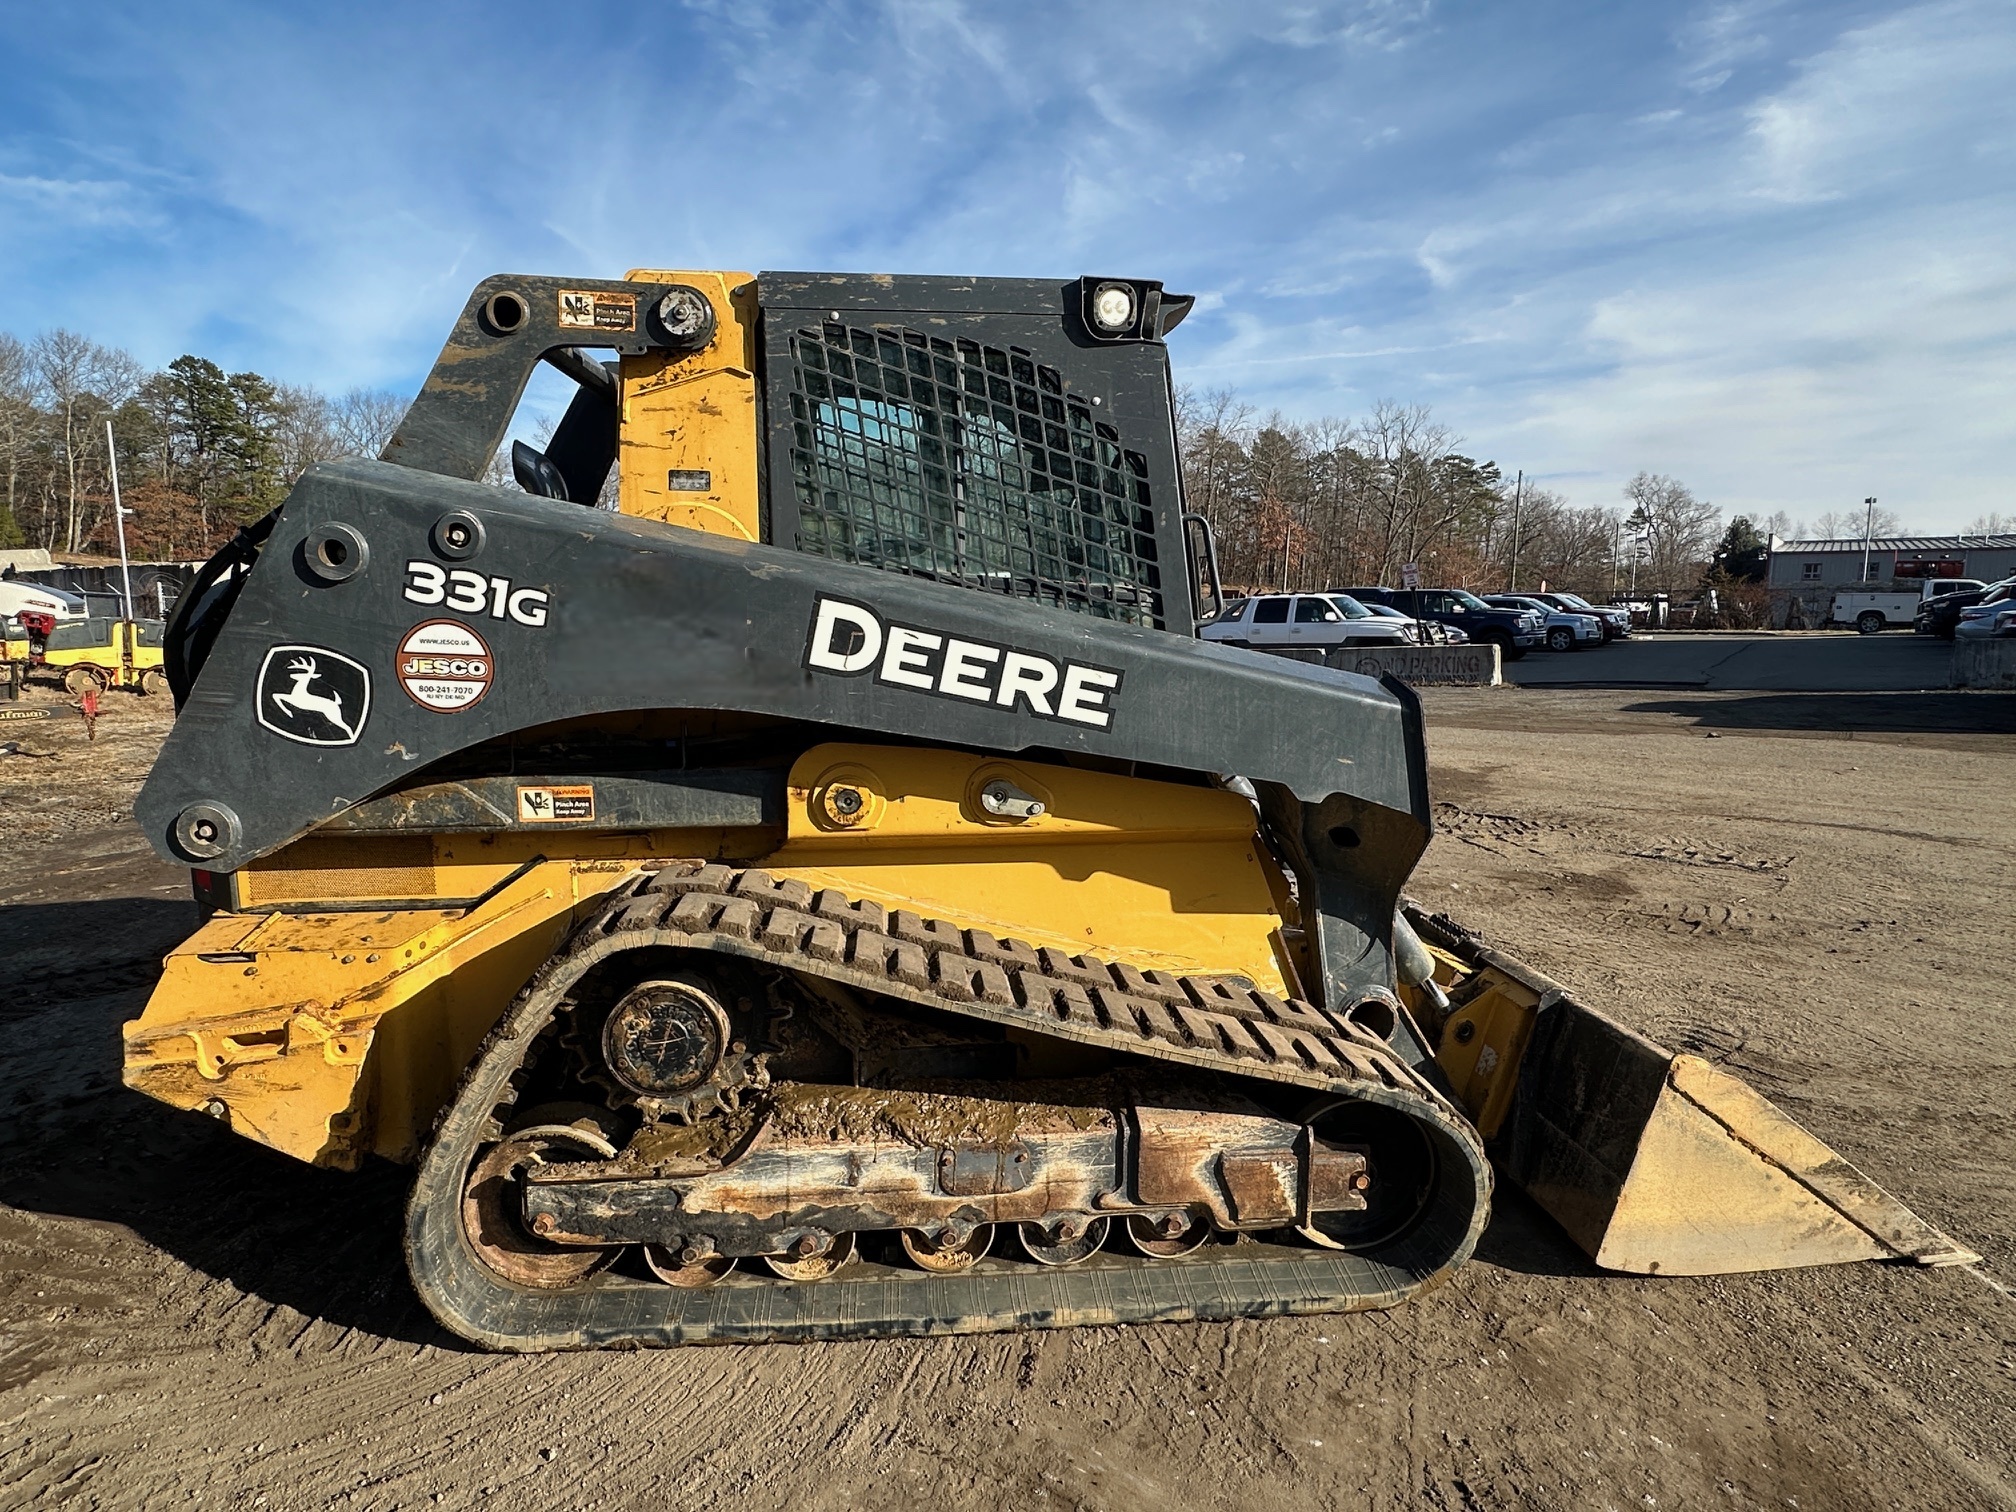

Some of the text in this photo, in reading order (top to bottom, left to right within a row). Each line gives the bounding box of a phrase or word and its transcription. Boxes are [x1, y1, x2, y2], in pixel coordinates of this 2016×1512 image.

[404, 561, 548, 627] 331G
[419, 638, 470, 646] WWW.JESCO.US
[403, 657, 487, 677] JESCO
[808, 598, 1119, 727] DEERE
[1384, 655, 1480, 674] NO PARKING
[418, 684, 473, 695] 800-241-7070
